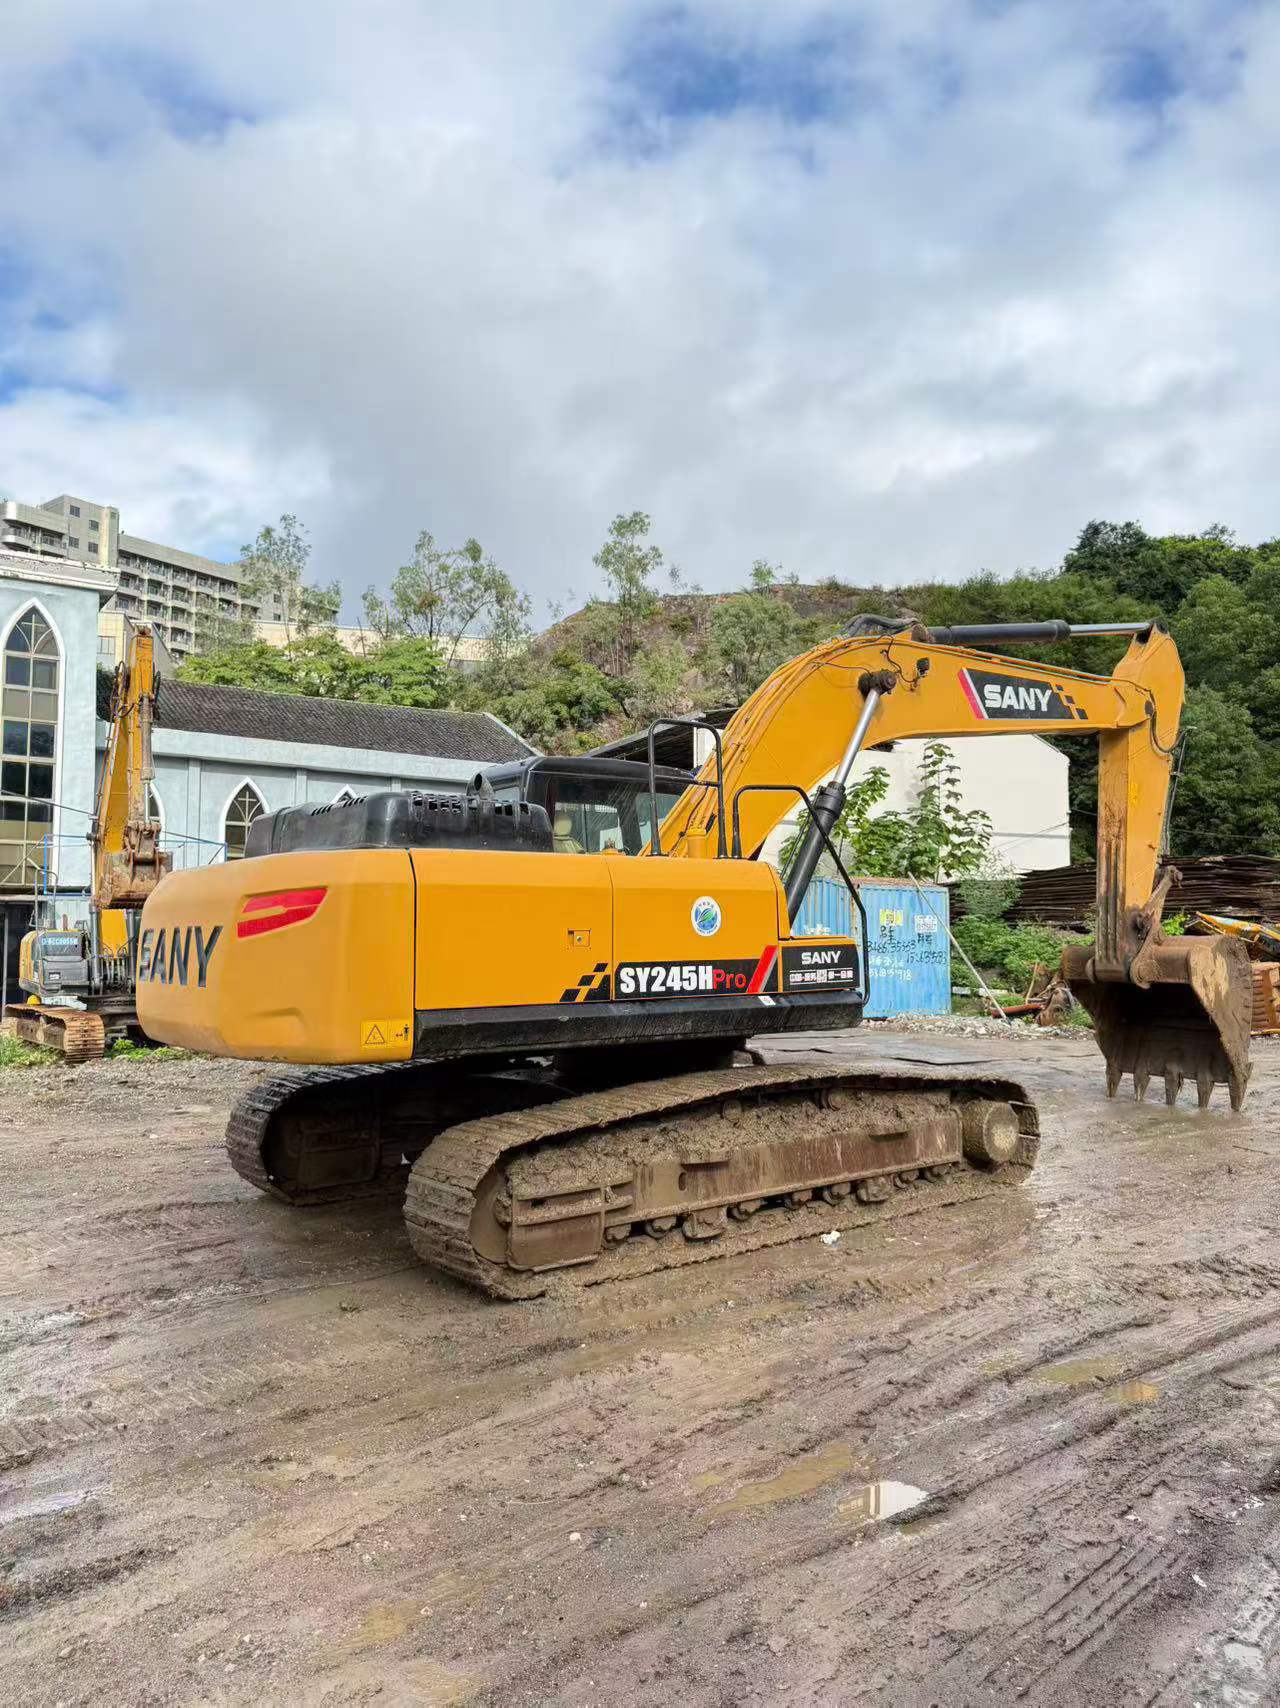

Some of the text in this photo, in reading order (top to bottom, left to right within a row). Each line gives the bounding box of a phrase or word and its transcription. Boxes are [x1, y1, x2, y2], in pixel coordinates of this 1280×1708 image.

[984, 684, 1052, 711] SANY
[139, 926, 223, 987] SANY
[801, 950, 841, 965] SANY
